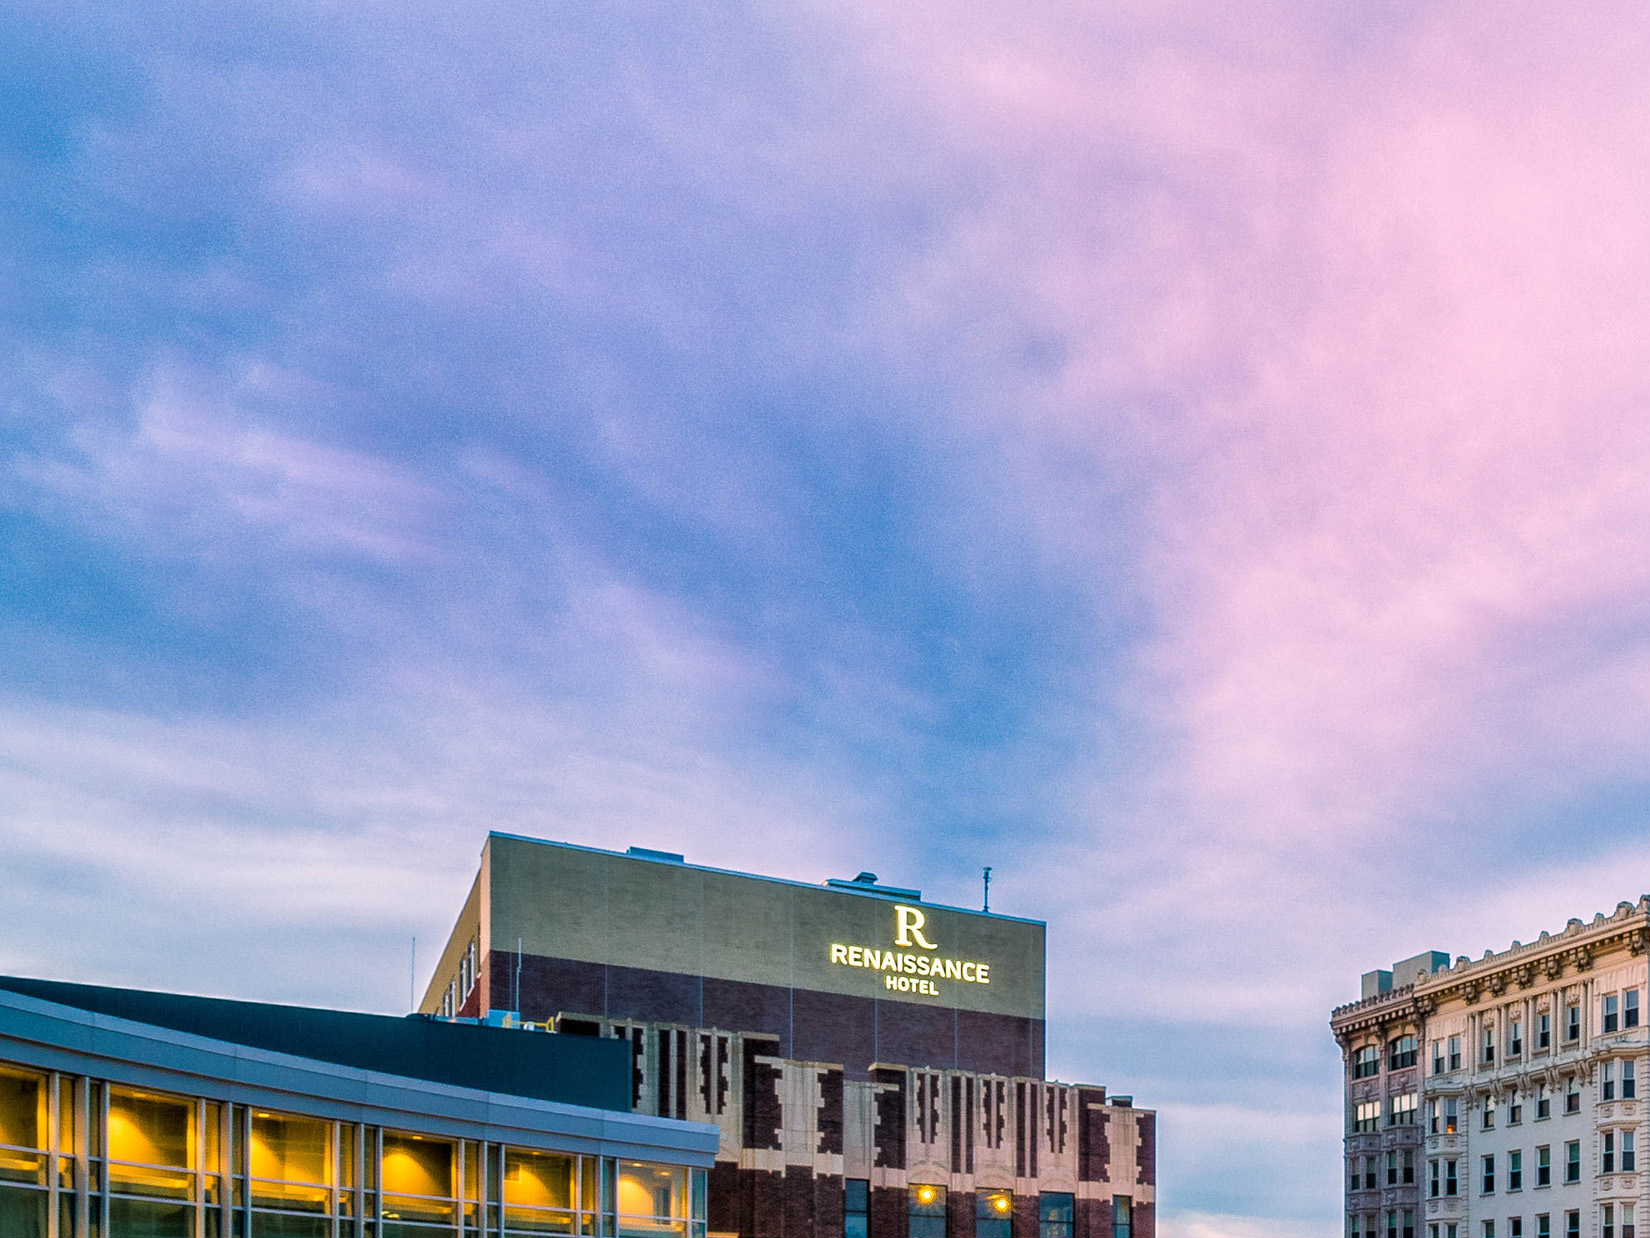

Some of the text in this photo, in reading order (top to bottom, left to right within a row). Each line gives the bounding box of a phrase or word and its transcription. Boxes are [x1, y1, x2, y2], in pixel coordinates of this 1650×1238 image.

[894, 905, 938, 950] R
[830, 943, 990, 984] RENAISSANCE
[886, 975, 939, 996] HOTEL
